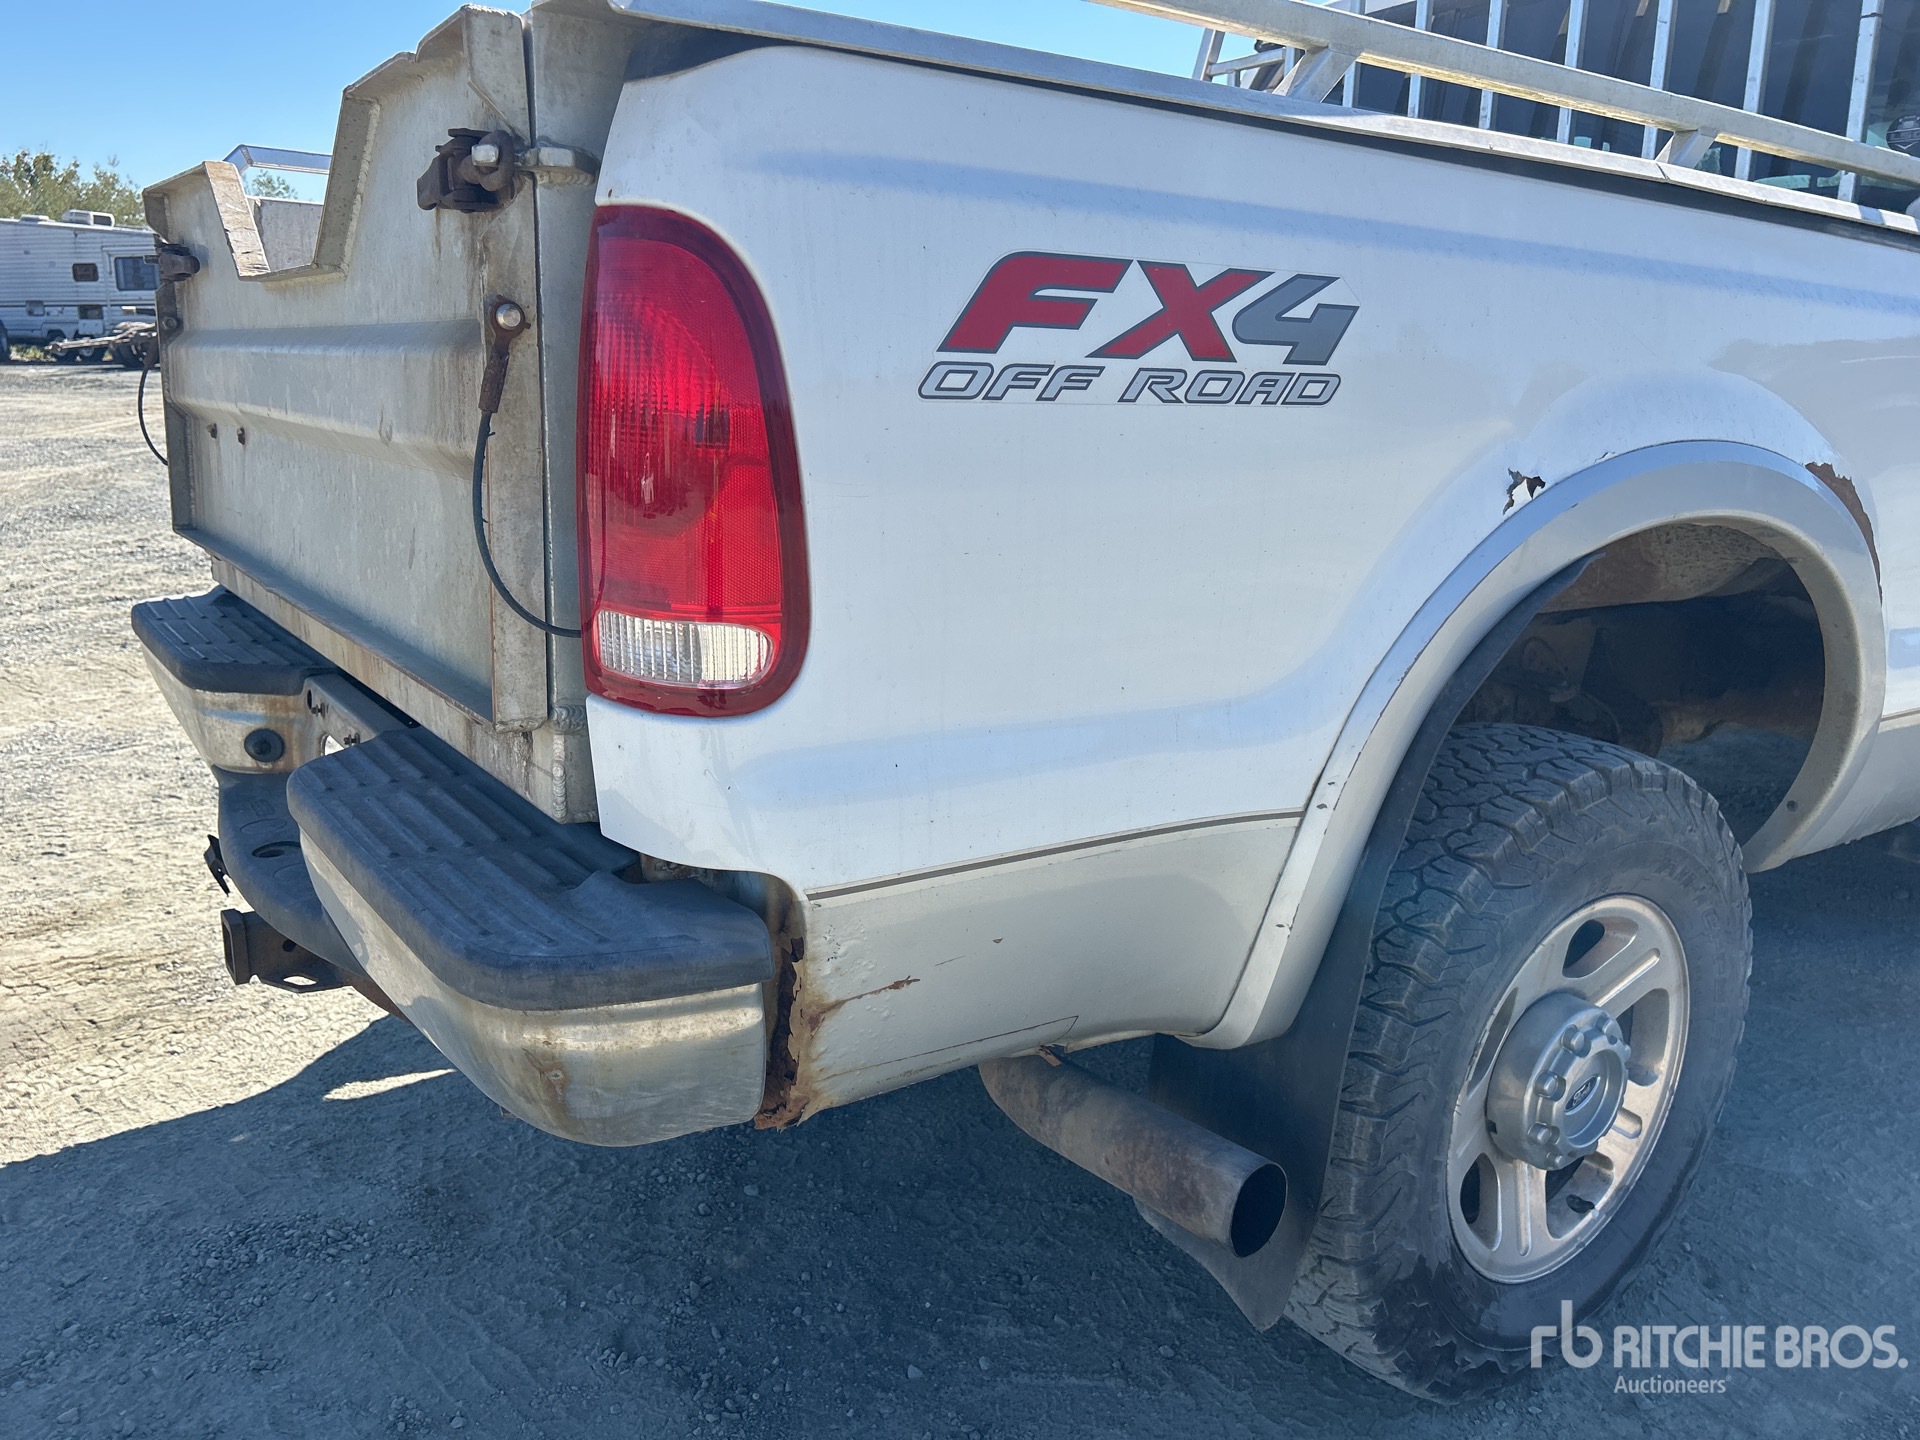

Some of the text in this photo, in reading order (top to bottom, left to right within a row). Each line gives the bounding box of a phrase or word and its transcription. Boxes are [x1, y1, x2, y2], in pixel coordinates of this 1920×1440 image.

[936, 251, 1360, 366] FX4
[917, 361, 1341, 406] OFF ROAD
